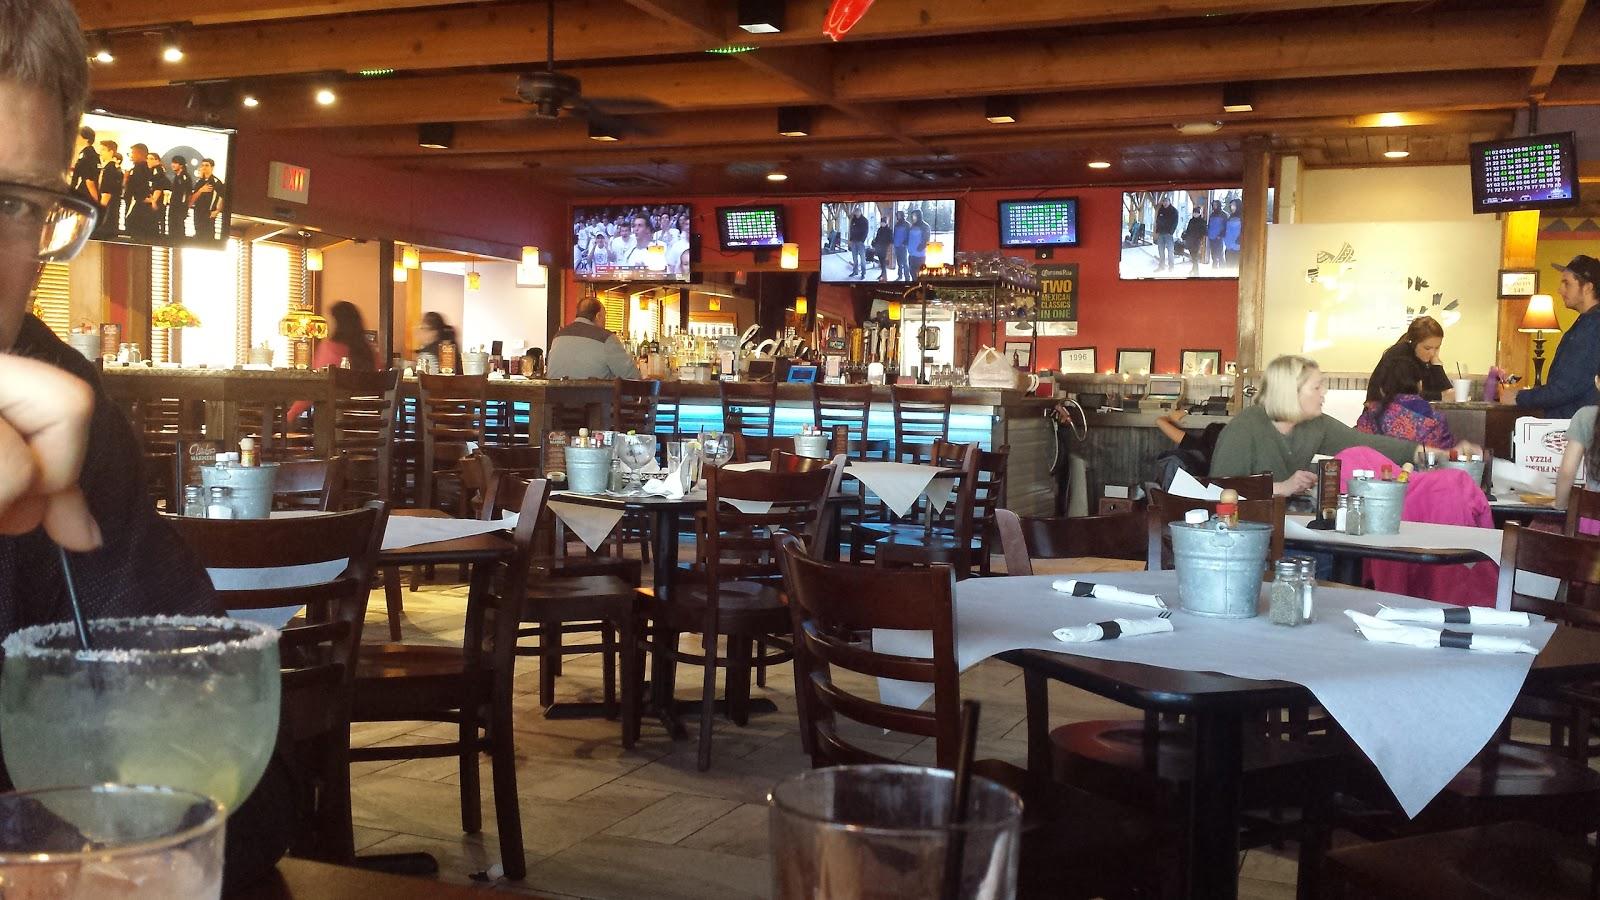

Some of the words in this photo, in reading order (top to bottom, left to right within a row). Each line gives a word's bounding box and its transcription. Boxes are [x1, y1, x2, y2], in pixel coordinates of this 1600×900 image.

[1041, 280, 1072, 293] TWO
[1041, 310, 1050, 318] IN
[1053, 310, 1070, 318] ONE
